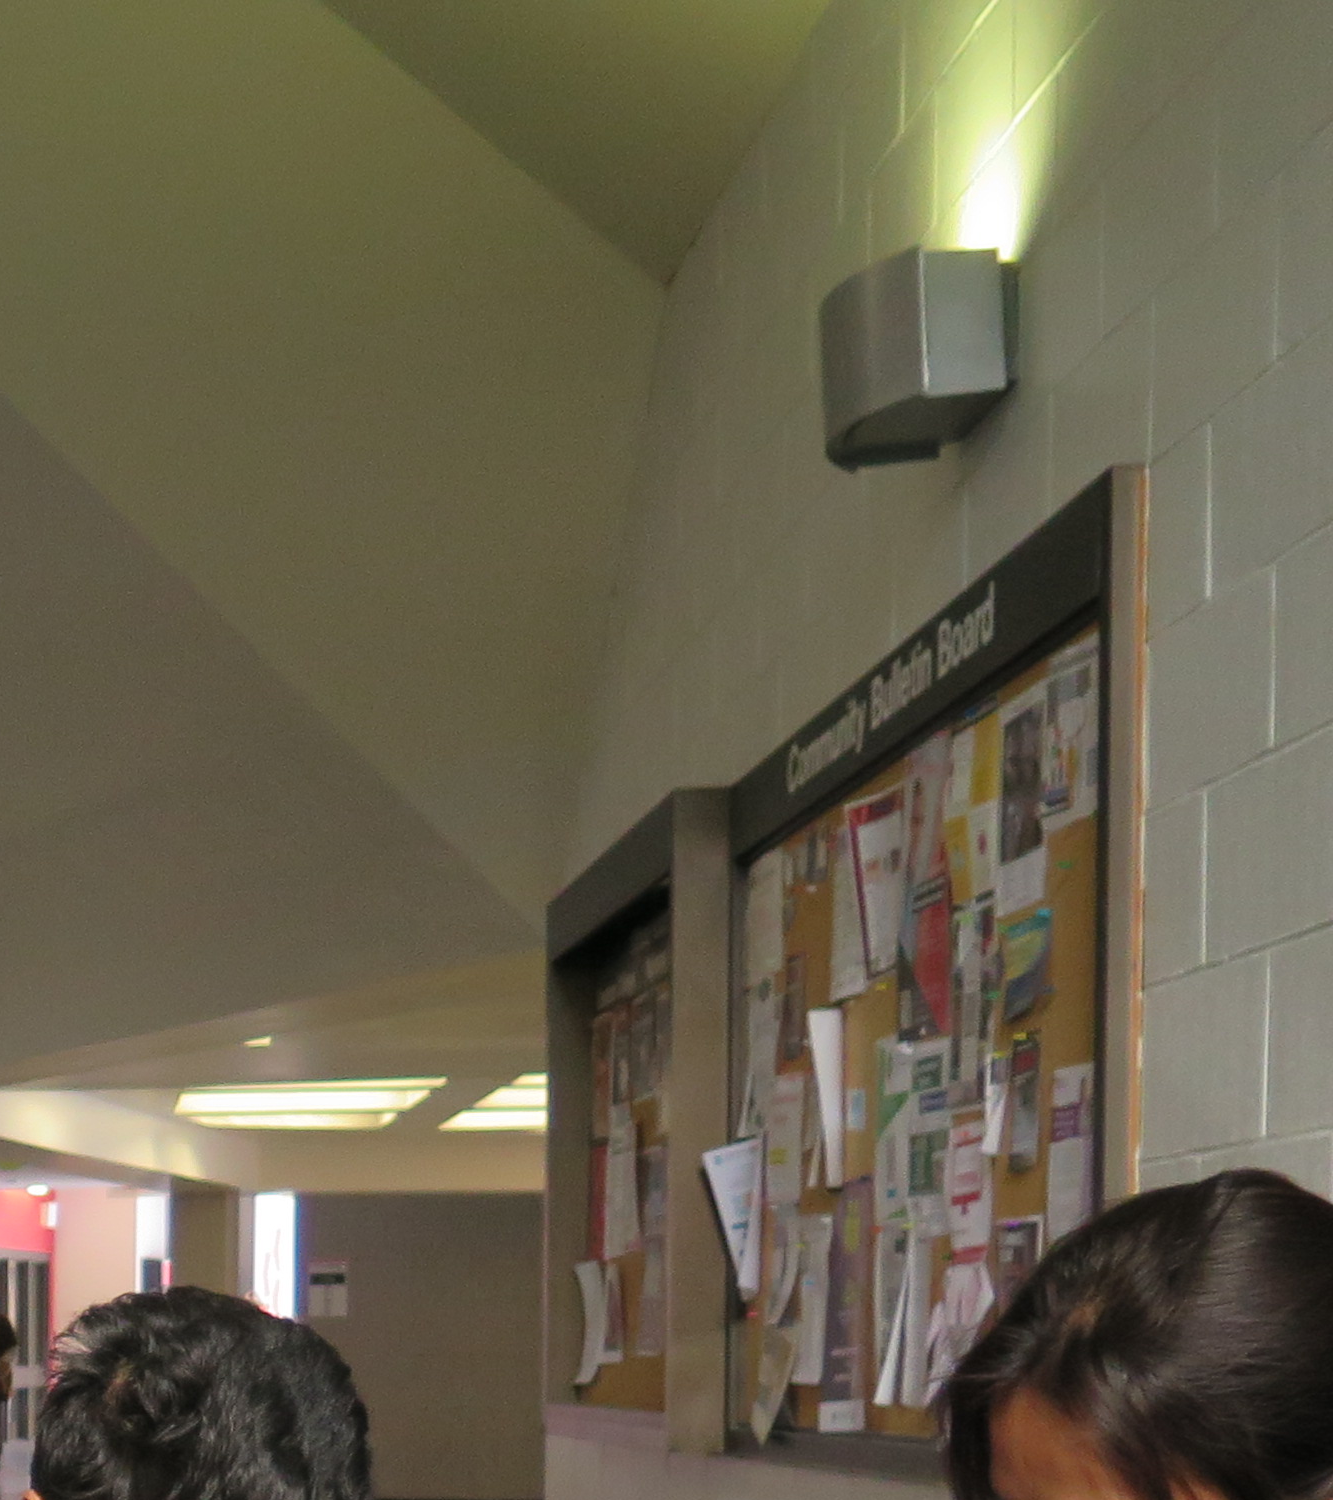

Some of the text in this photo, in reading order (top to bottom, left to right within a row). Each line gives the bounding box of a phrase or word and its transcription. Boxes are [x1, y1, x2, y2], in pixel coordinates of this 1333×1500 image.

[786, 580, 996, 793] Community Bulletin Board
